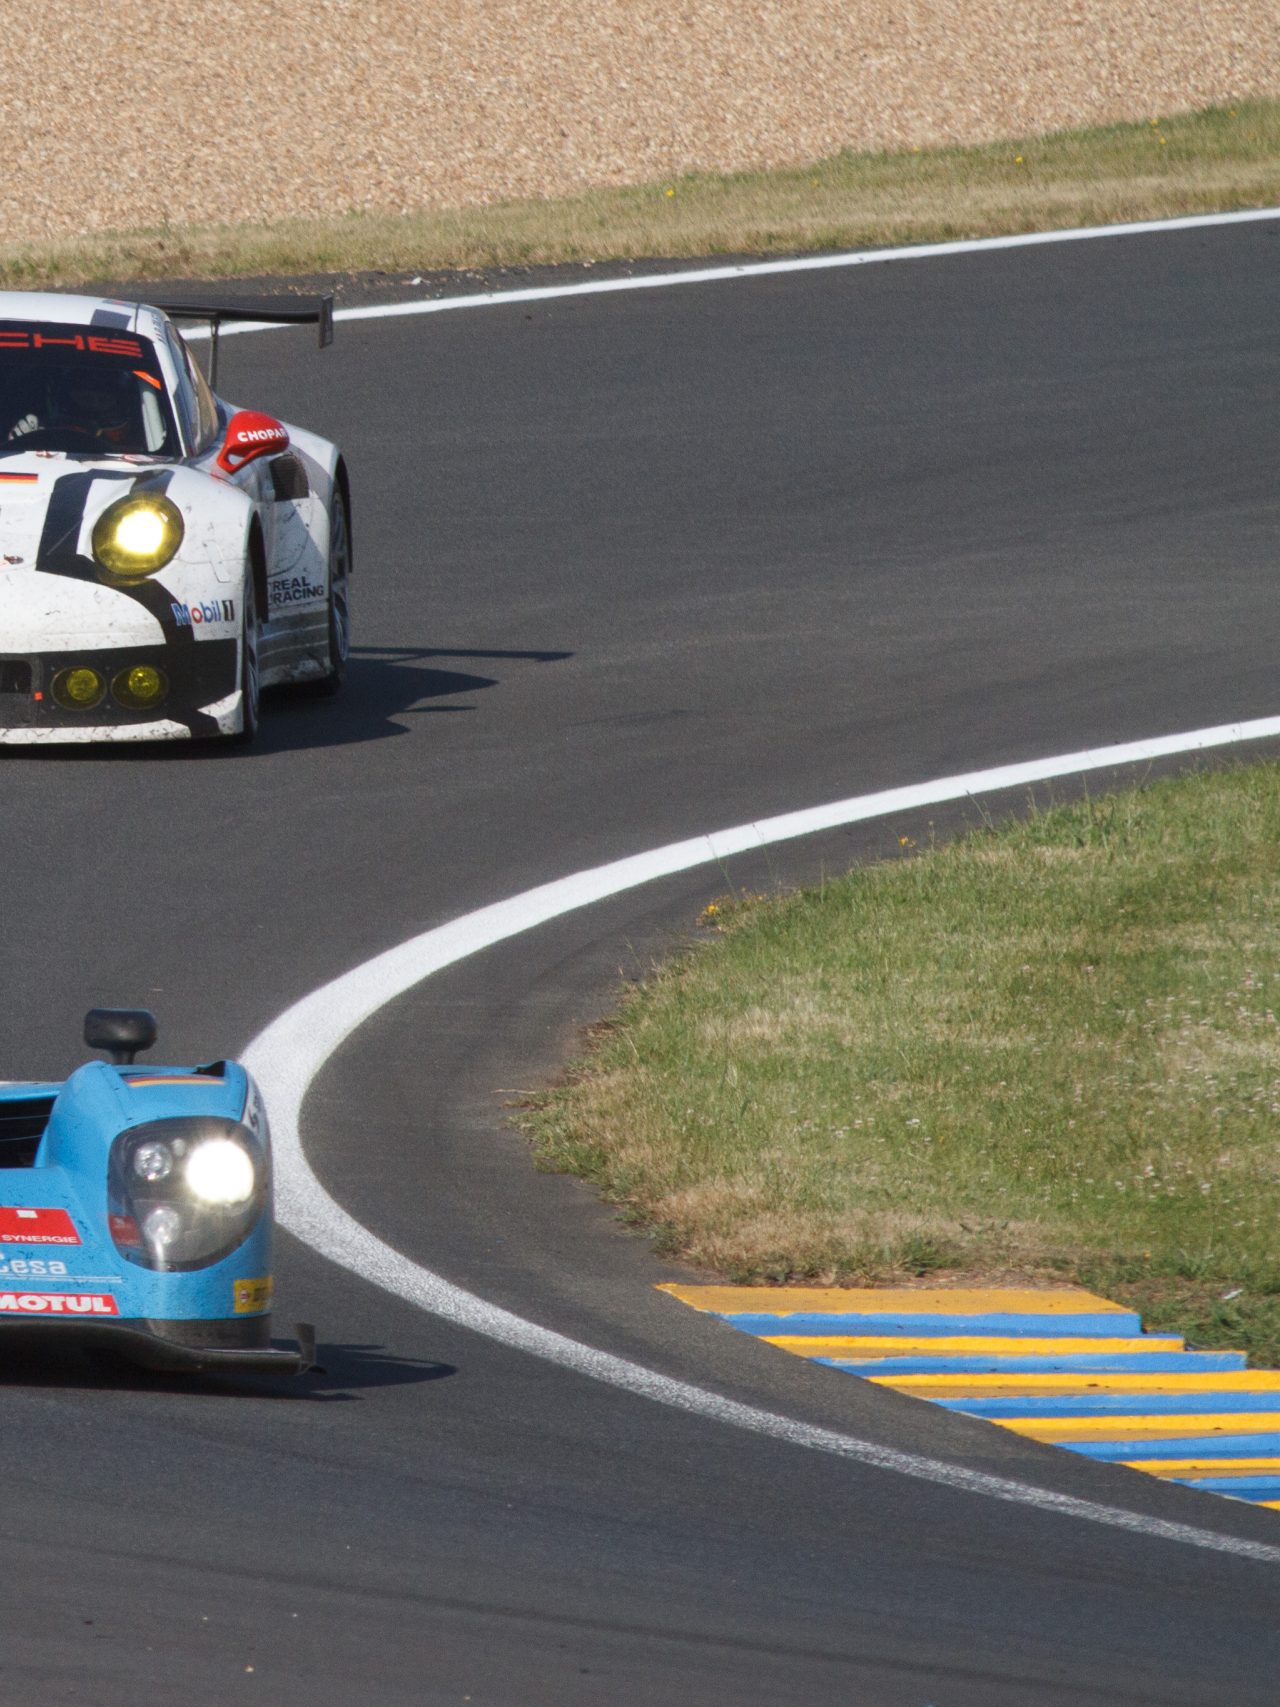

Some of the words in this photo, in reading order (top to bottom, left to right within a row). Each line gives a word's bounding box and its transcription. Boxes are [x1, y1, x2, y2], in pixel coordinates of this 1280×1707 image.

[272, 576, 311, 592] REAL
[272, 586, 324, 604] RACING
[171, 600, 220, 626] Mobil
[222, 600, 235, 622] 1
[1, 1234, 79, 1244] SYNERGIE
